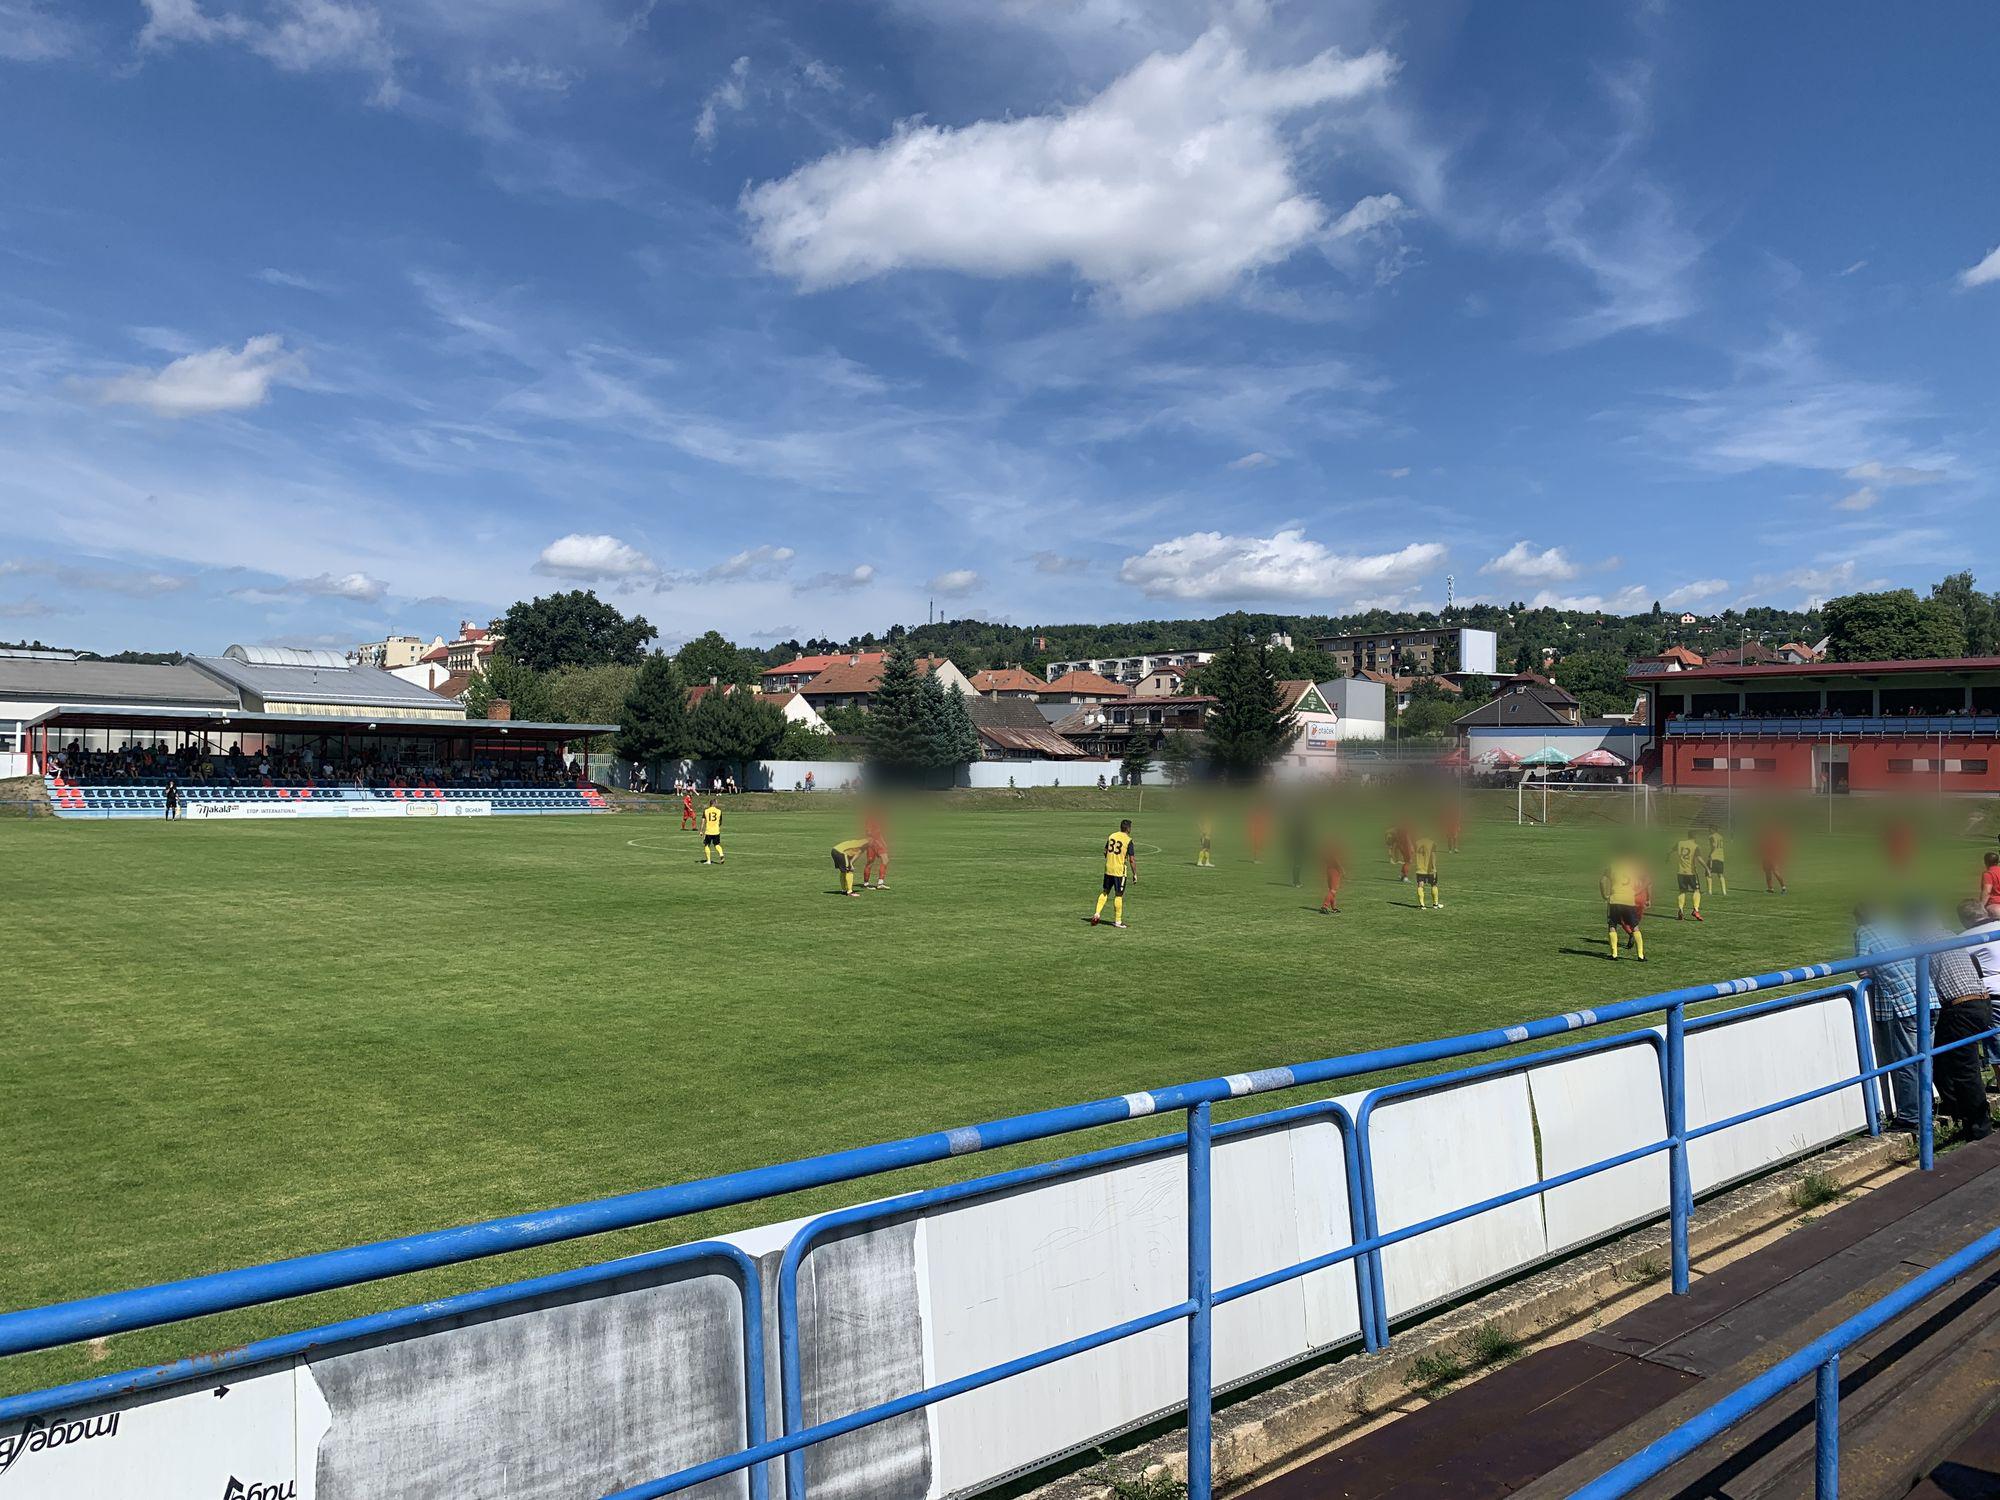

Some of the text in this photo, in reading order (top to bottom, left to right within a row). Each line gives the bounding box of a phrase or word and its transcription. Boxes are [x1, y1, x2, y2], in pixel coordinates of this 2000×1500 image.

[709, 812, 717, 821] 13
[1108, 839, 1123, 855] 33
[29, 1413, 120, 1453] Image
